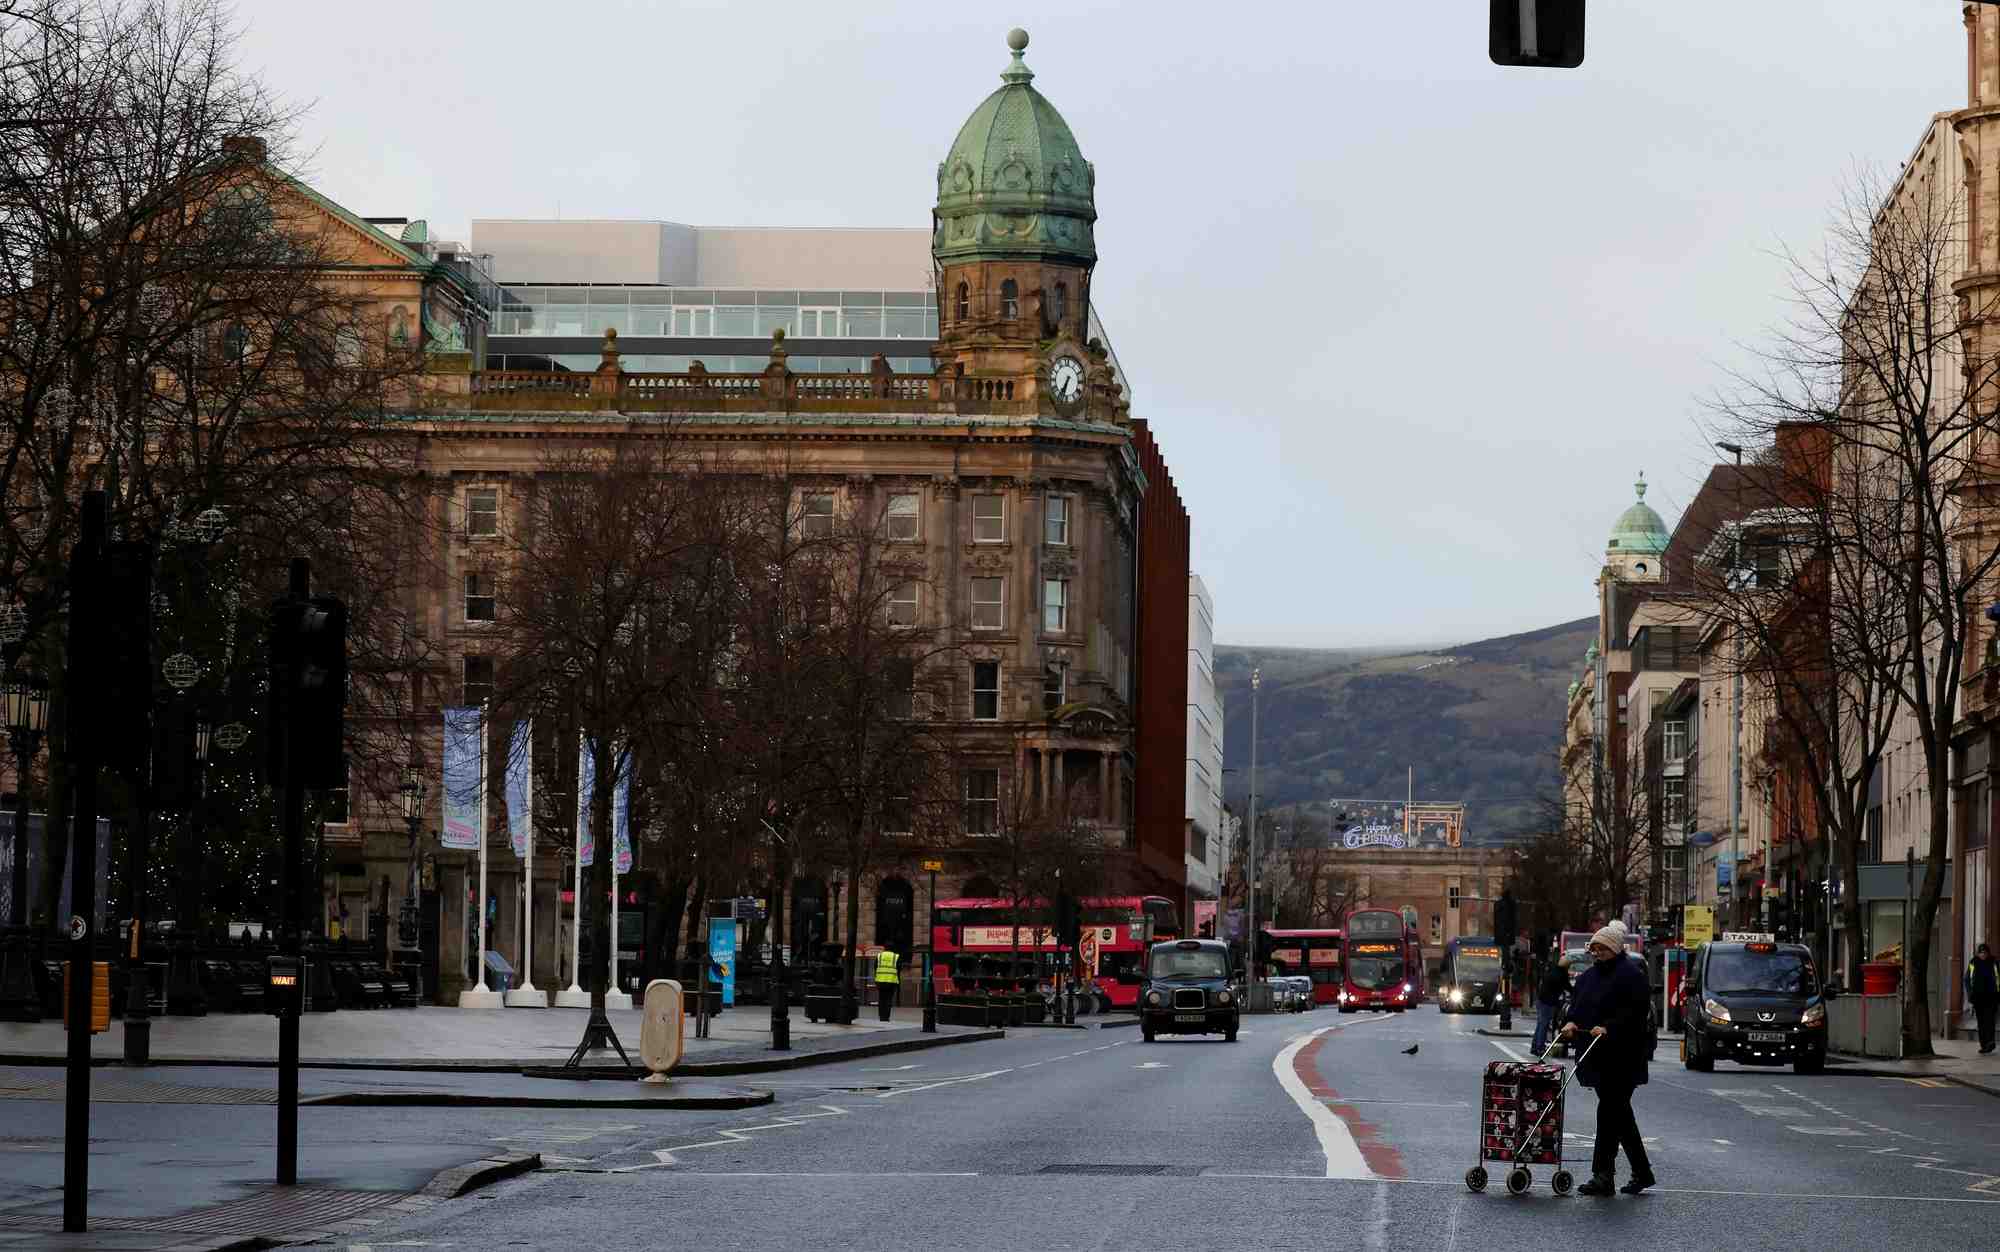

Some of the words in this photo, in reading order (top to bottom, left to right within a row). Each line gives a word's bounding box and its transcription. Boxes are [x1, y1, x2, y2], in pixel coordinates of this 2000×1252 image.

[1366, 825, 1391, 833] HAPPY
[1344, 826, 1406, 849] CHRISTMAS
[272, 976, 296, 985] WAIT
